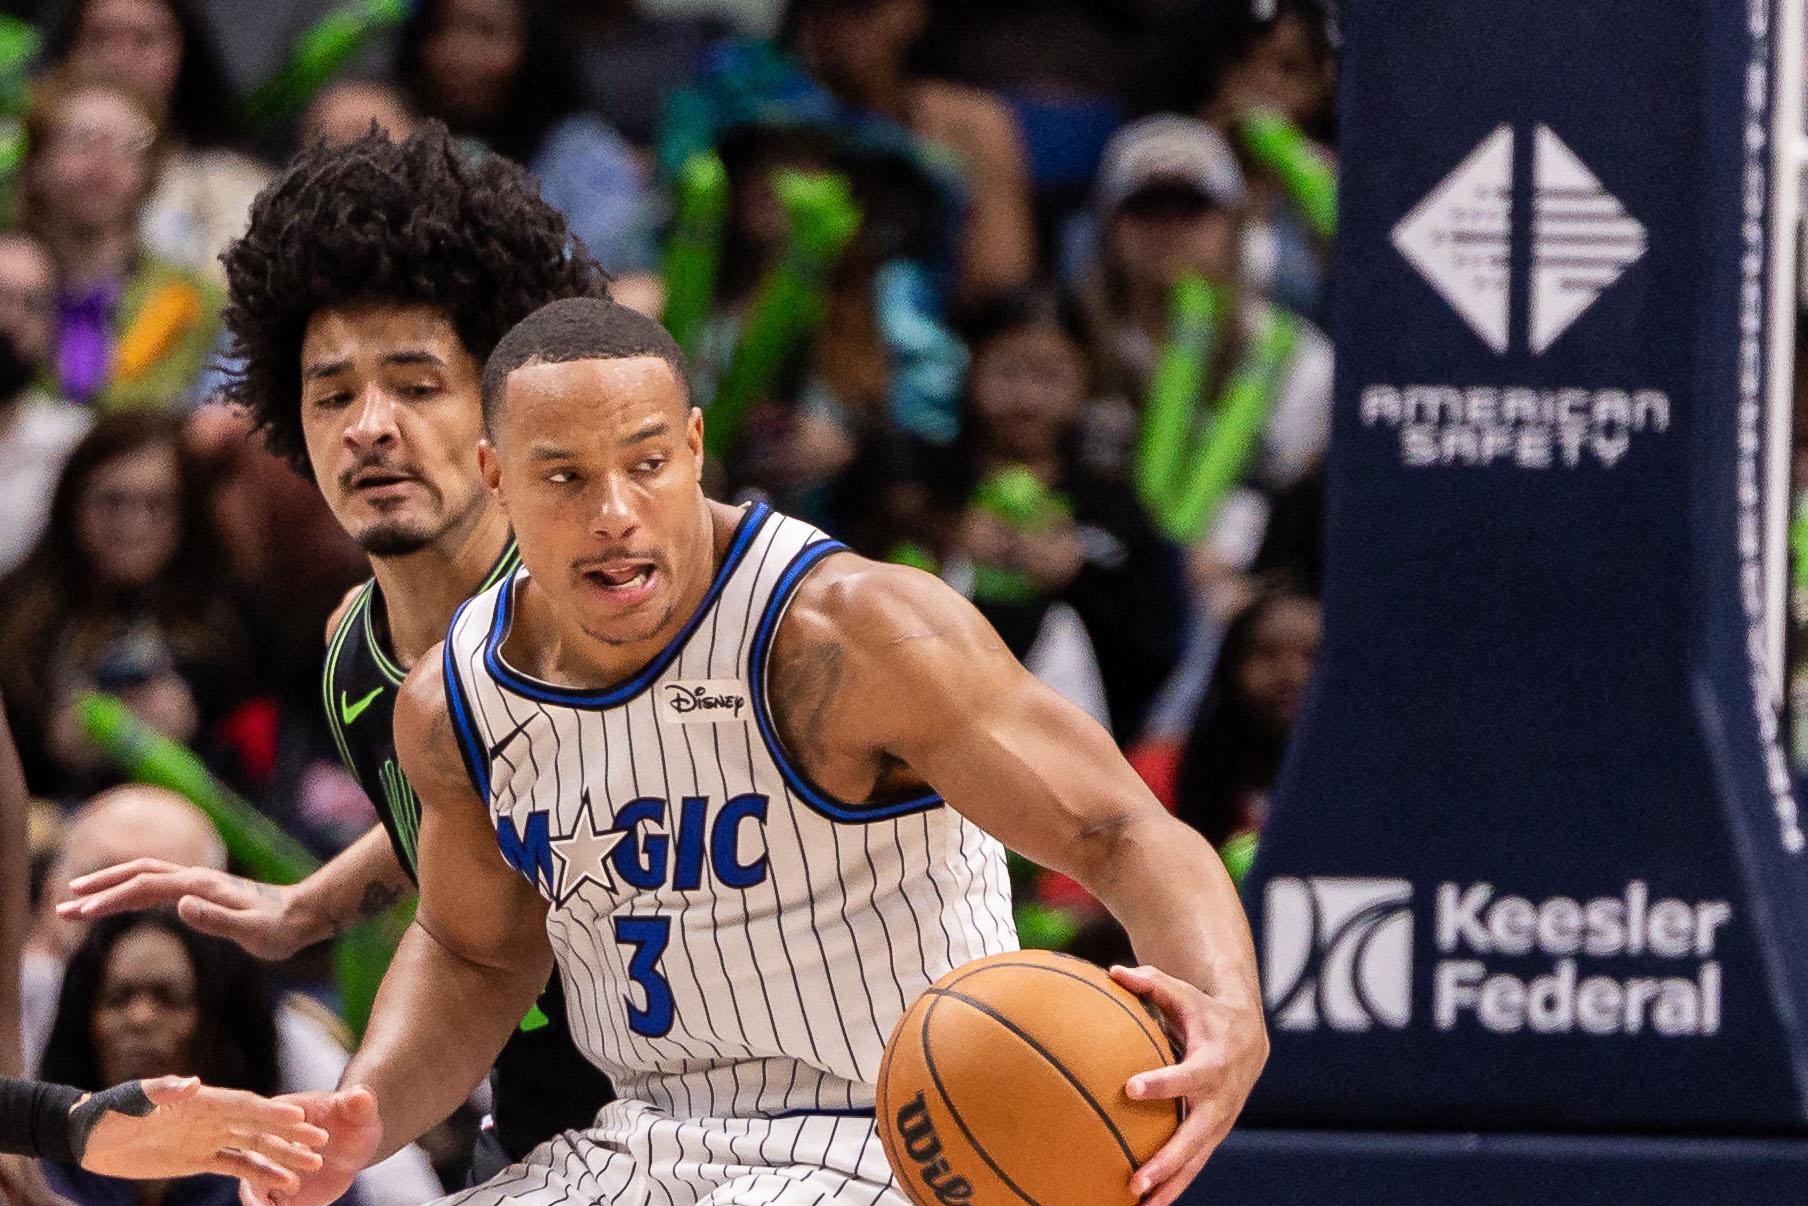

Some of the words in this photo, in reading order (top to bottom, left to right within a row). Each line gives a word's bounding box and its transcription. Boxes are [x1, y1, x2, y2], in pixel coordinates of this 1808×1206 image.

[1361, 386, 1671, 433] AMERICAN
[1400, 424, 1630, 469] SAFETY
[496, 788, 770, 911] MGIC
[1436, 879, 1732, 957] Keesler
[613, 915, 676, 1038] 3
[1433, 957, 1722, 1036] Federal
